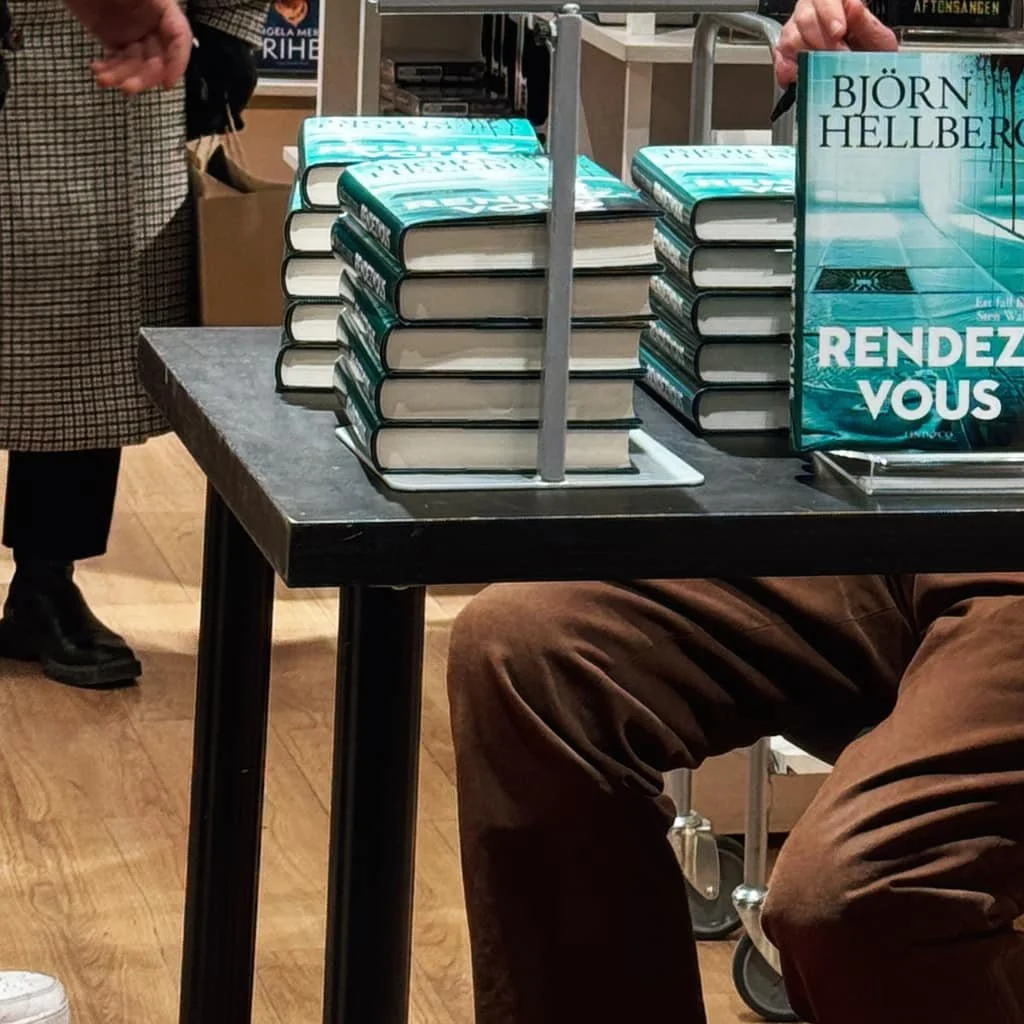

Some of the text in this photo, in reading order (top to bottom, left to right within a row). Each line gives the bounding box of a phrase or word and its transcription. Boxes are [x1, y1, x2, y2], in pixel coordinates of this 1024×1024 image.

[263, 37, 320, 61] RIHE
[832, 68, 972, 117] BJÖRN
[857, 379, 1002, 421] VOUS
